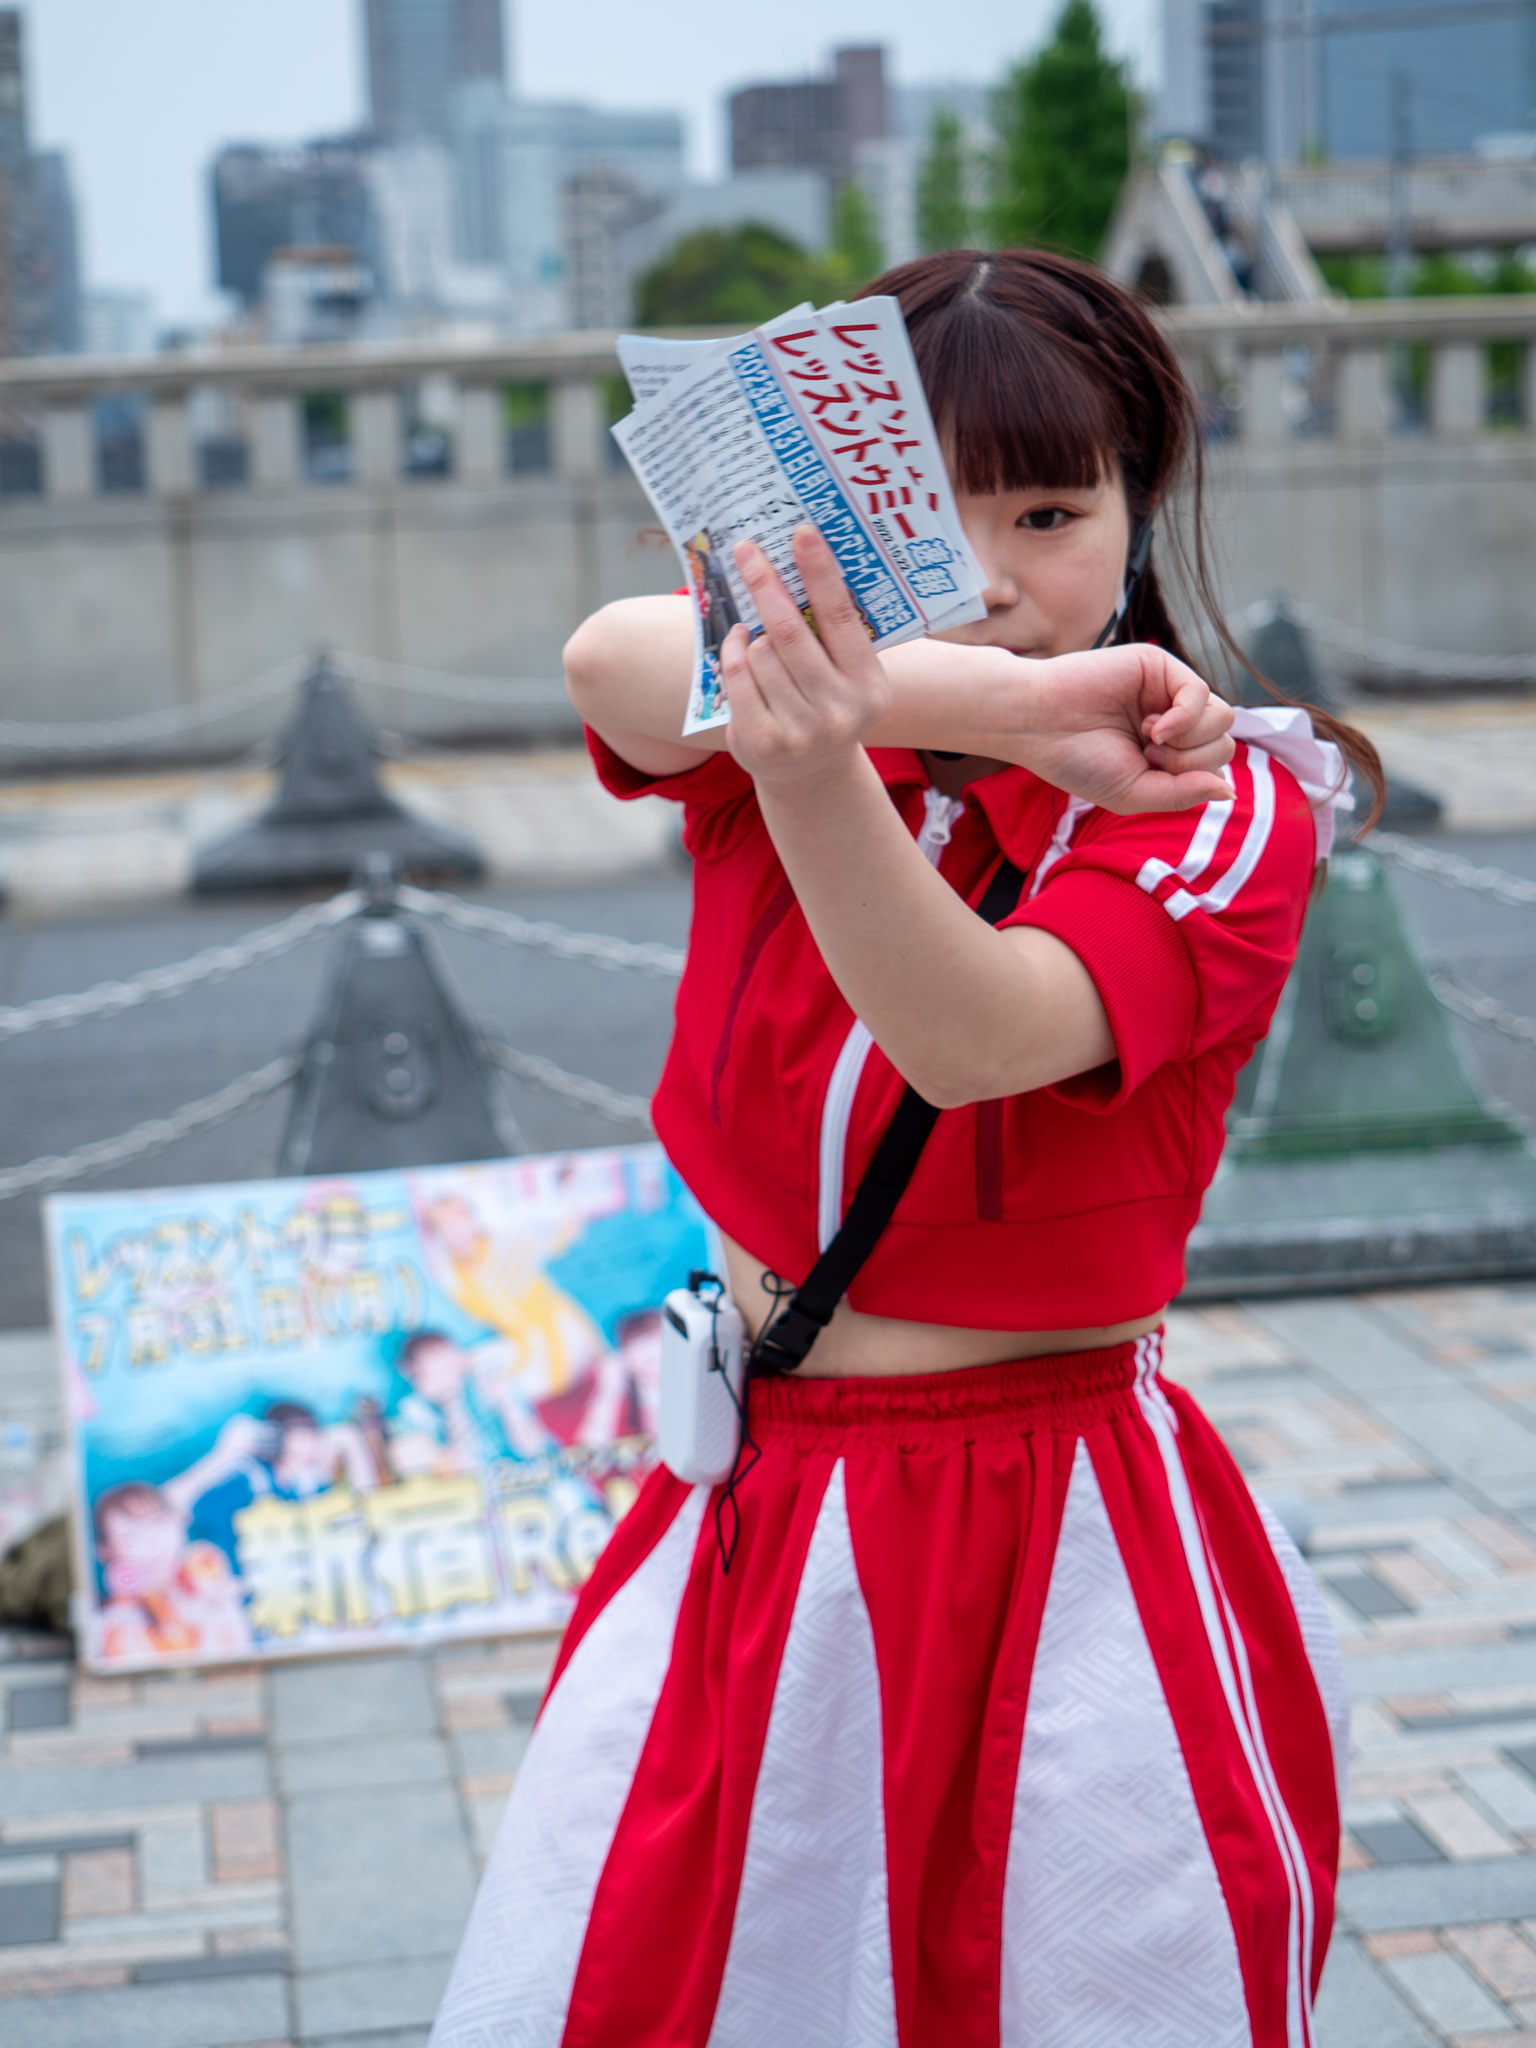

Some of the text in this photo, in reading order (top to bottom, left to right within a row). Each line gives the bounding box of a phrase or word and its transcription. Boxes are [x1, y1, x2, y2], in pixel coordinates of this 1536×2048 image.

[770, 329, 917, 539] レッスントゥミー
[871, 518, 912, 572] 2022.10.22
[906, 537, 959, 598] 速報
